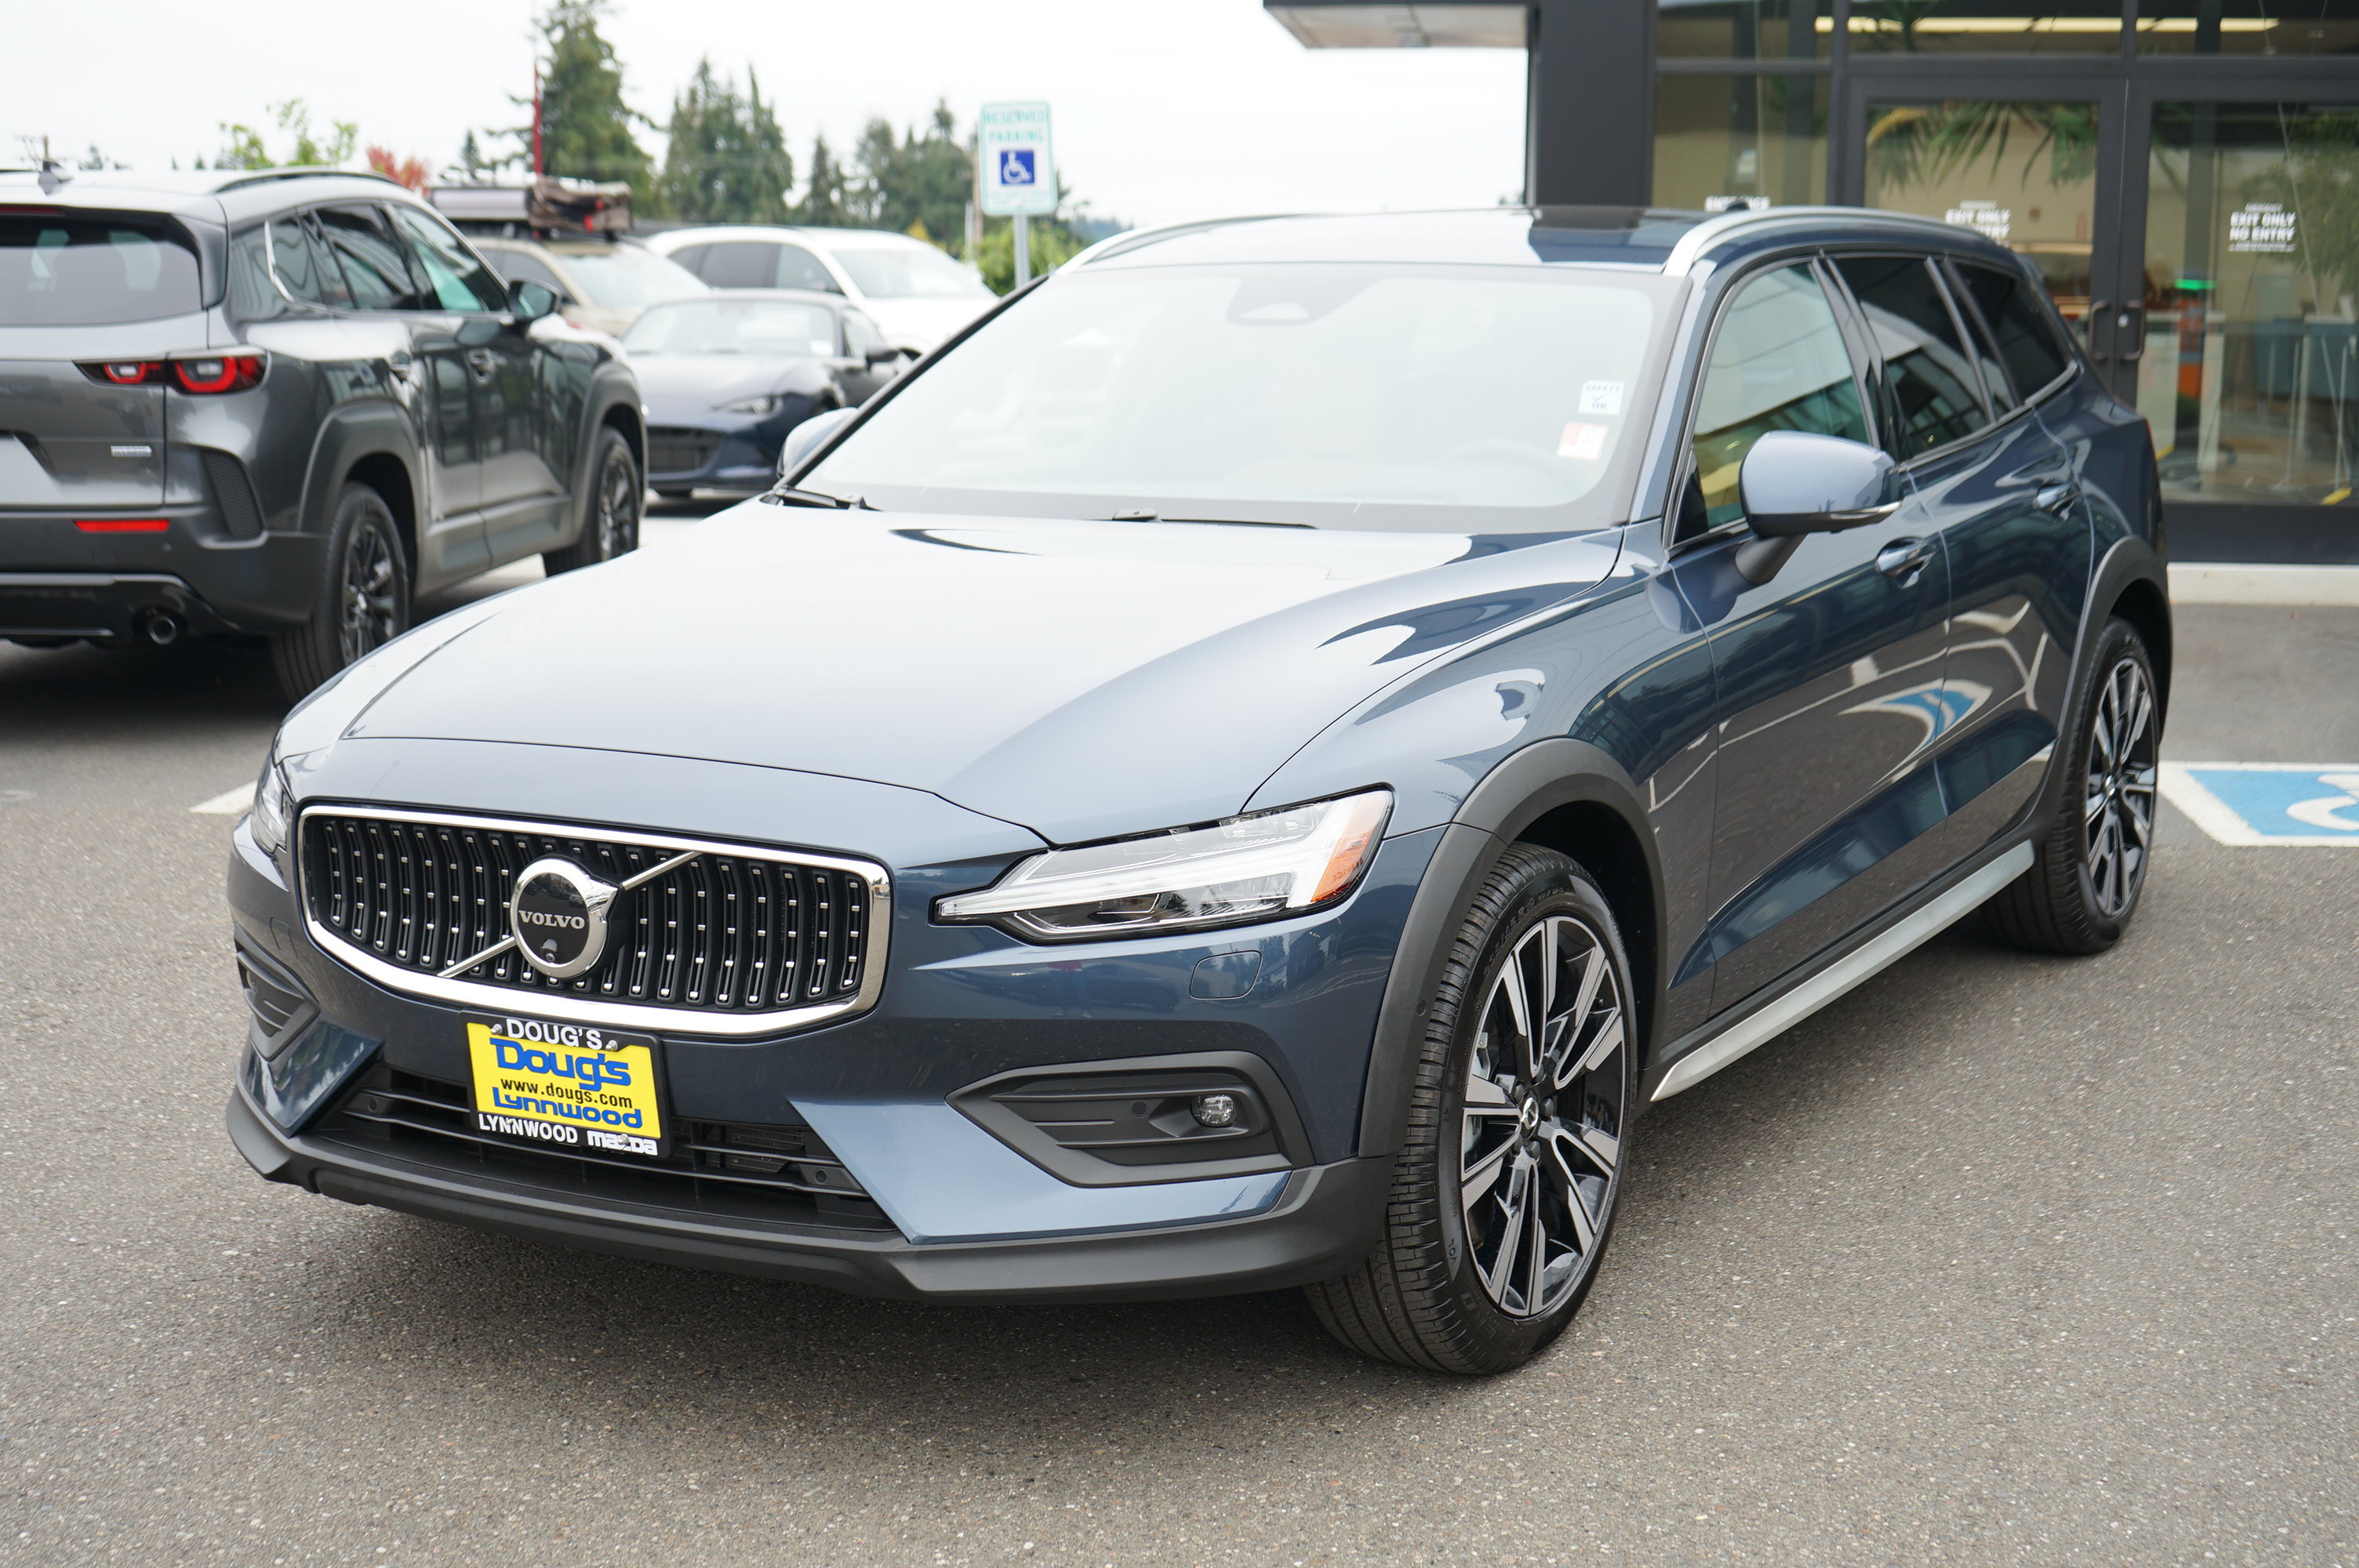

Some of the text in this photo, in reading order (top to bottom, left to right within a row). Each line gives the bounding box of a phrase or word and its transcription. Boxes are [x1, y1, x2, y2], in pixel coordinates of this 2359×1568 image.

[989, 129, 1044, 143] PARKING
[1705, 195, 1770, 212] ENTNCE
[1946, 209, 2012, 225] EXIT ONLY
[2230, 212, 2296, 227] EXIT ONLY
[1972, 224, 2011, 239] TRY
[2230, 226, 2295, 241] NO ENTRY
[1585, 383, 1621, 392] SAFETY
[518, 909, 585, 930] VOLVO
[506, 1018, 603, 1051] DOUG'S
[500, 1078, 633, 1109] www.dougs.com
[493, 1087, 643, 1129] Lynnwood
[478, 1113, 579, 1144] LYNNWOOD
